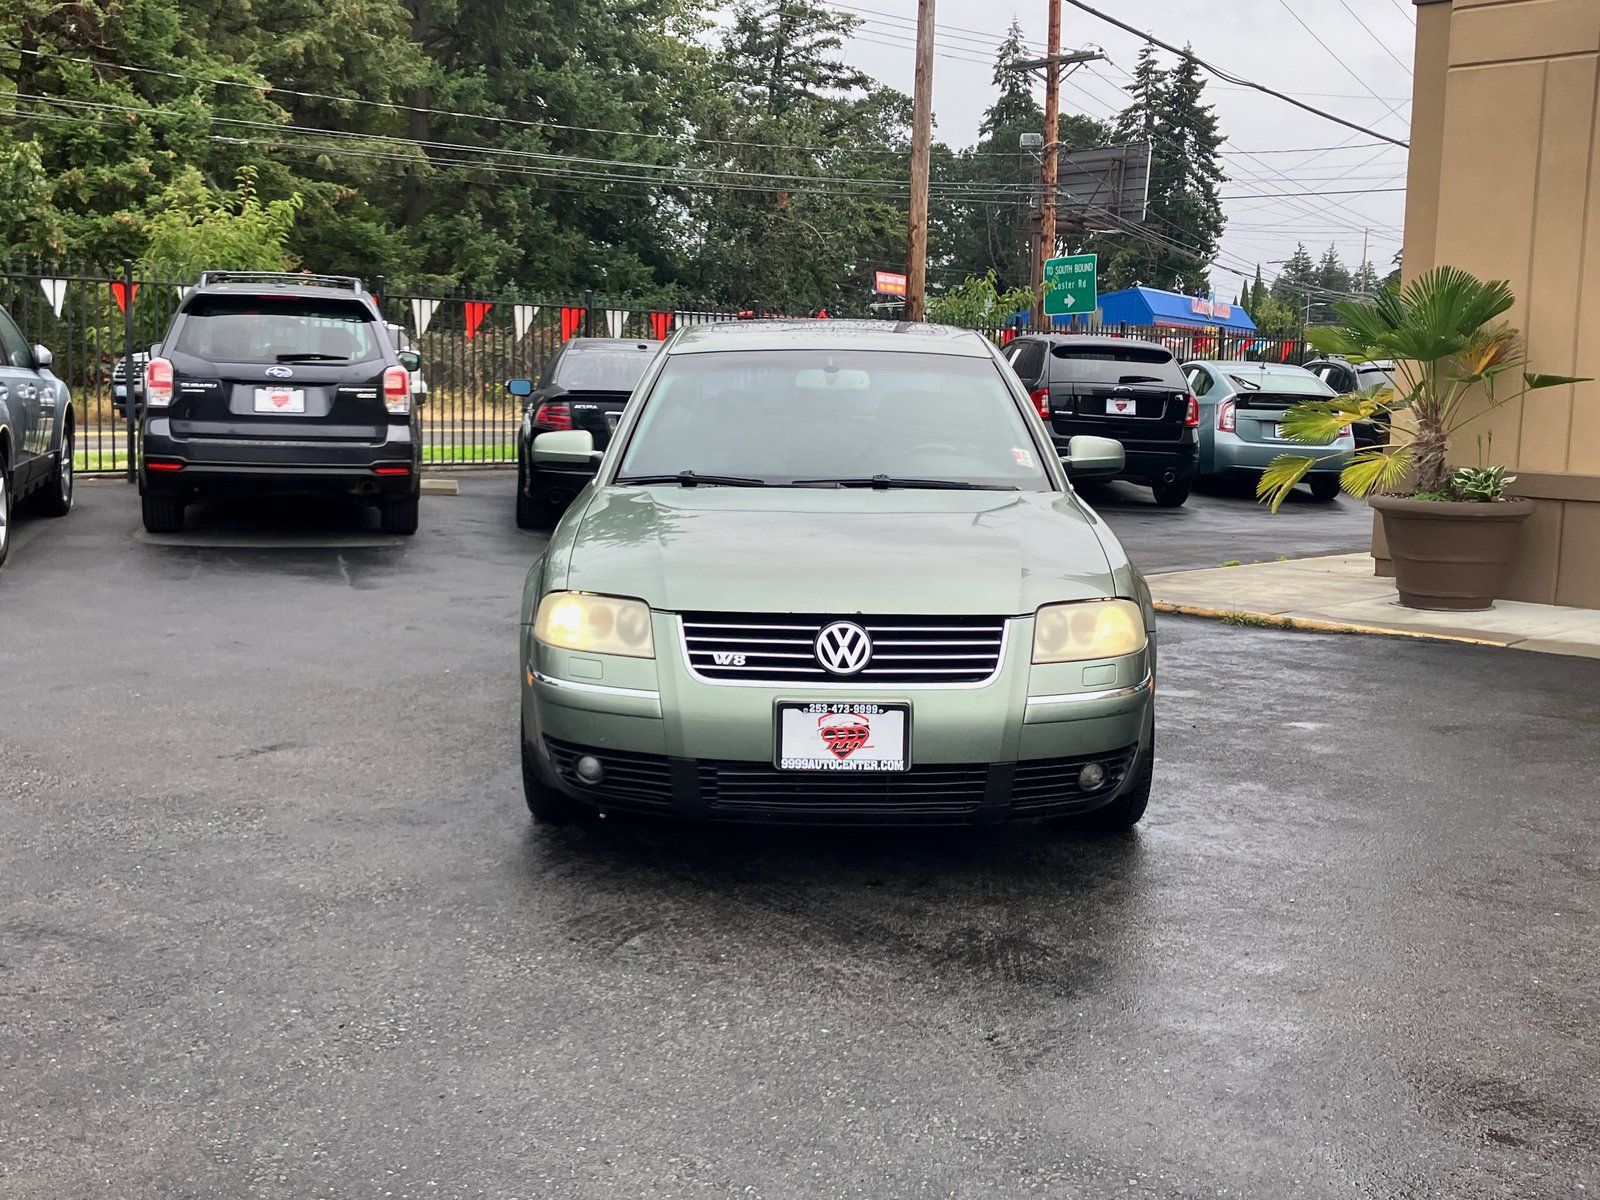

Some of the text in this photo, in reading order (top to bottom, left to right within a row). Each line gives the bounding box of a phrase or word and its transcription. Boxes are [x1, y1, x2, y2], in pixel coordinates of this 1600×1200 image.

[1046, 262, 1094, 276] TO SOUTH BOUND
[1078, 279, 1087, 288] Rd
[712, 652, 746, 666] W8
[809, 703, 878, 714] 253-473-9999
[780, 758, 904, 771] 9999AUTOCENTER.COM
